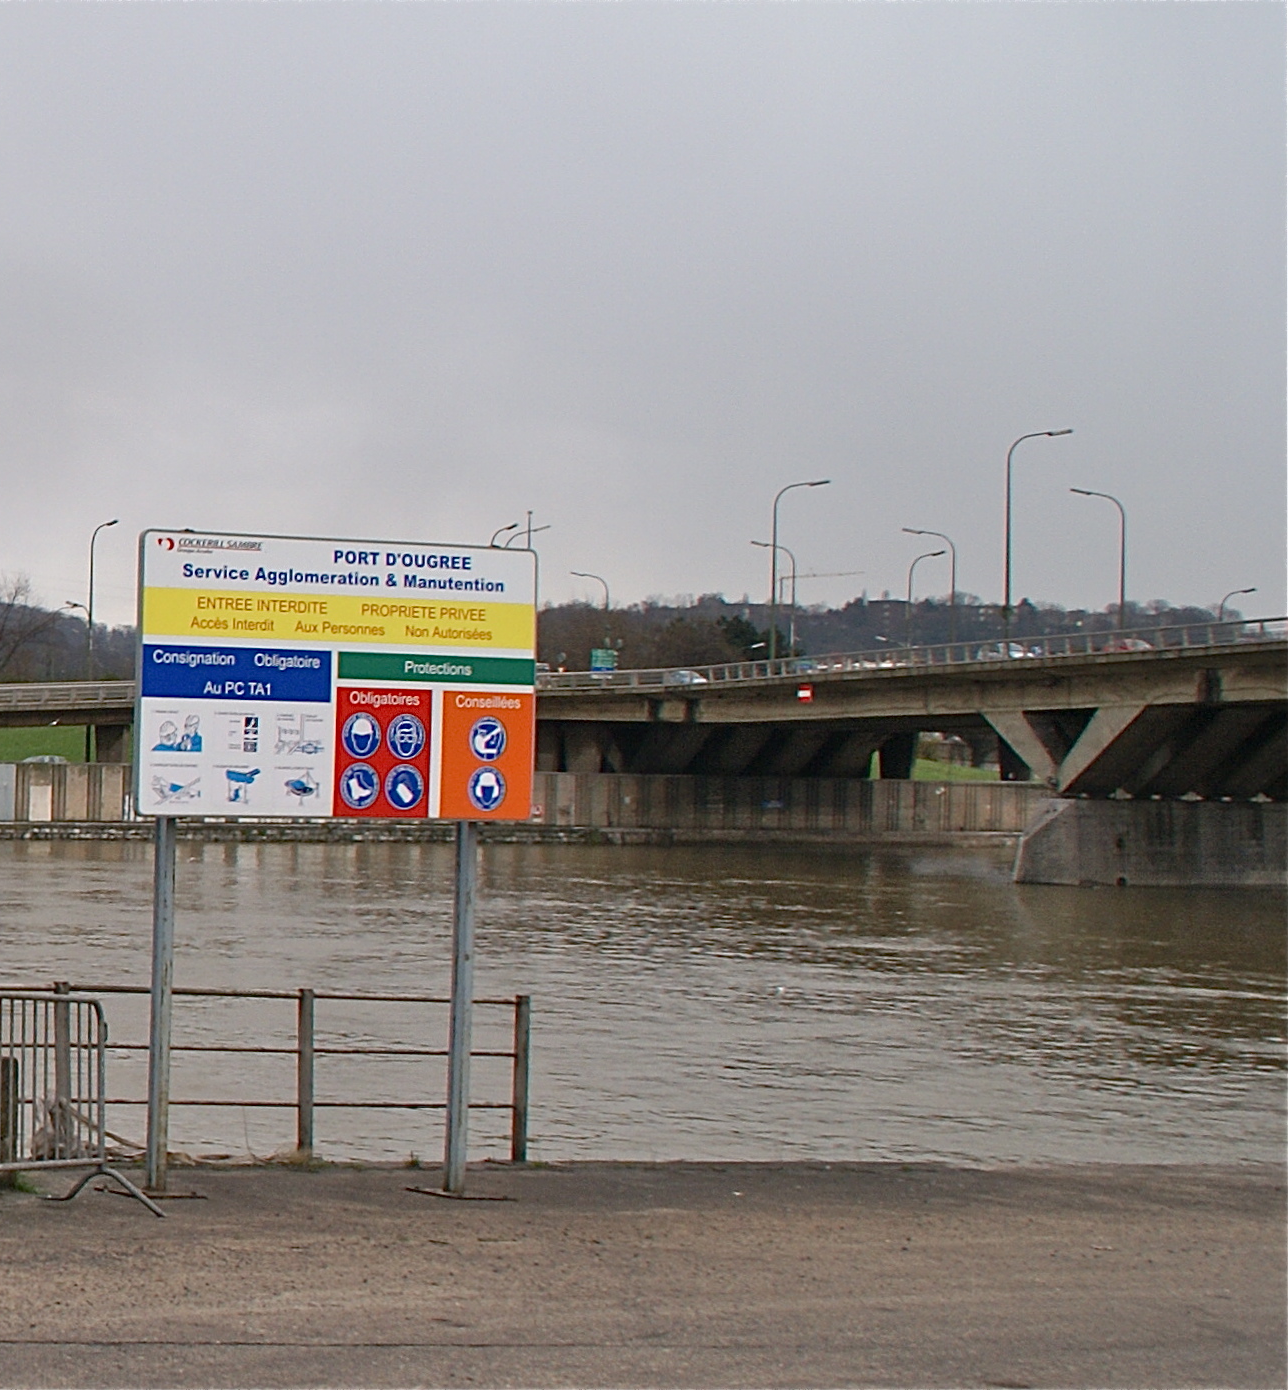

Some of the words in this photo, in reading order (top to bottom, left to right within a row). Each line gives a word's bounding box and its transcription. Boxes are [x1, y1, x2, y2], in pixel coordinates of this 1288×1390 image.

[334, 550, 379, 566] PORT
[386, 553, 472, 570] D'OUGREE
[183, 563, 249, 580] Service
[255, 567, 379, 586] Agglomeration
[385, 574, 397, 588] &
[403, 574, 505, 592] Manutention
[197, 596, 253, 612] ENTREE
[257, 599, 328, 615] INTERDITE
[361, 603, 437, 619] PROPRIETE
[440, 607, 486, 622] PRIVEE
[190, 616, 228, 630] Accès
[232, 617, 274, 632] Interdit
[295, 620, 319, 633] Aux
[322, 621, 385, 636] Personnes
[405, 625, 428, 638] Non
[432, 626, 492, 641] Autorisées
[153, 649, 235, 667] Consignation
[254, 653, 321, 670] Obligatoire
[404, 660, 472, 676] Protections
[203, 681, 222, 695] Au
[225, 682, 245, 695] PC
[248, 682, 271, 695] TA1
[349, 691, 420, 708] Obligatoires
[455, 695, 521, 709] Conseillées
